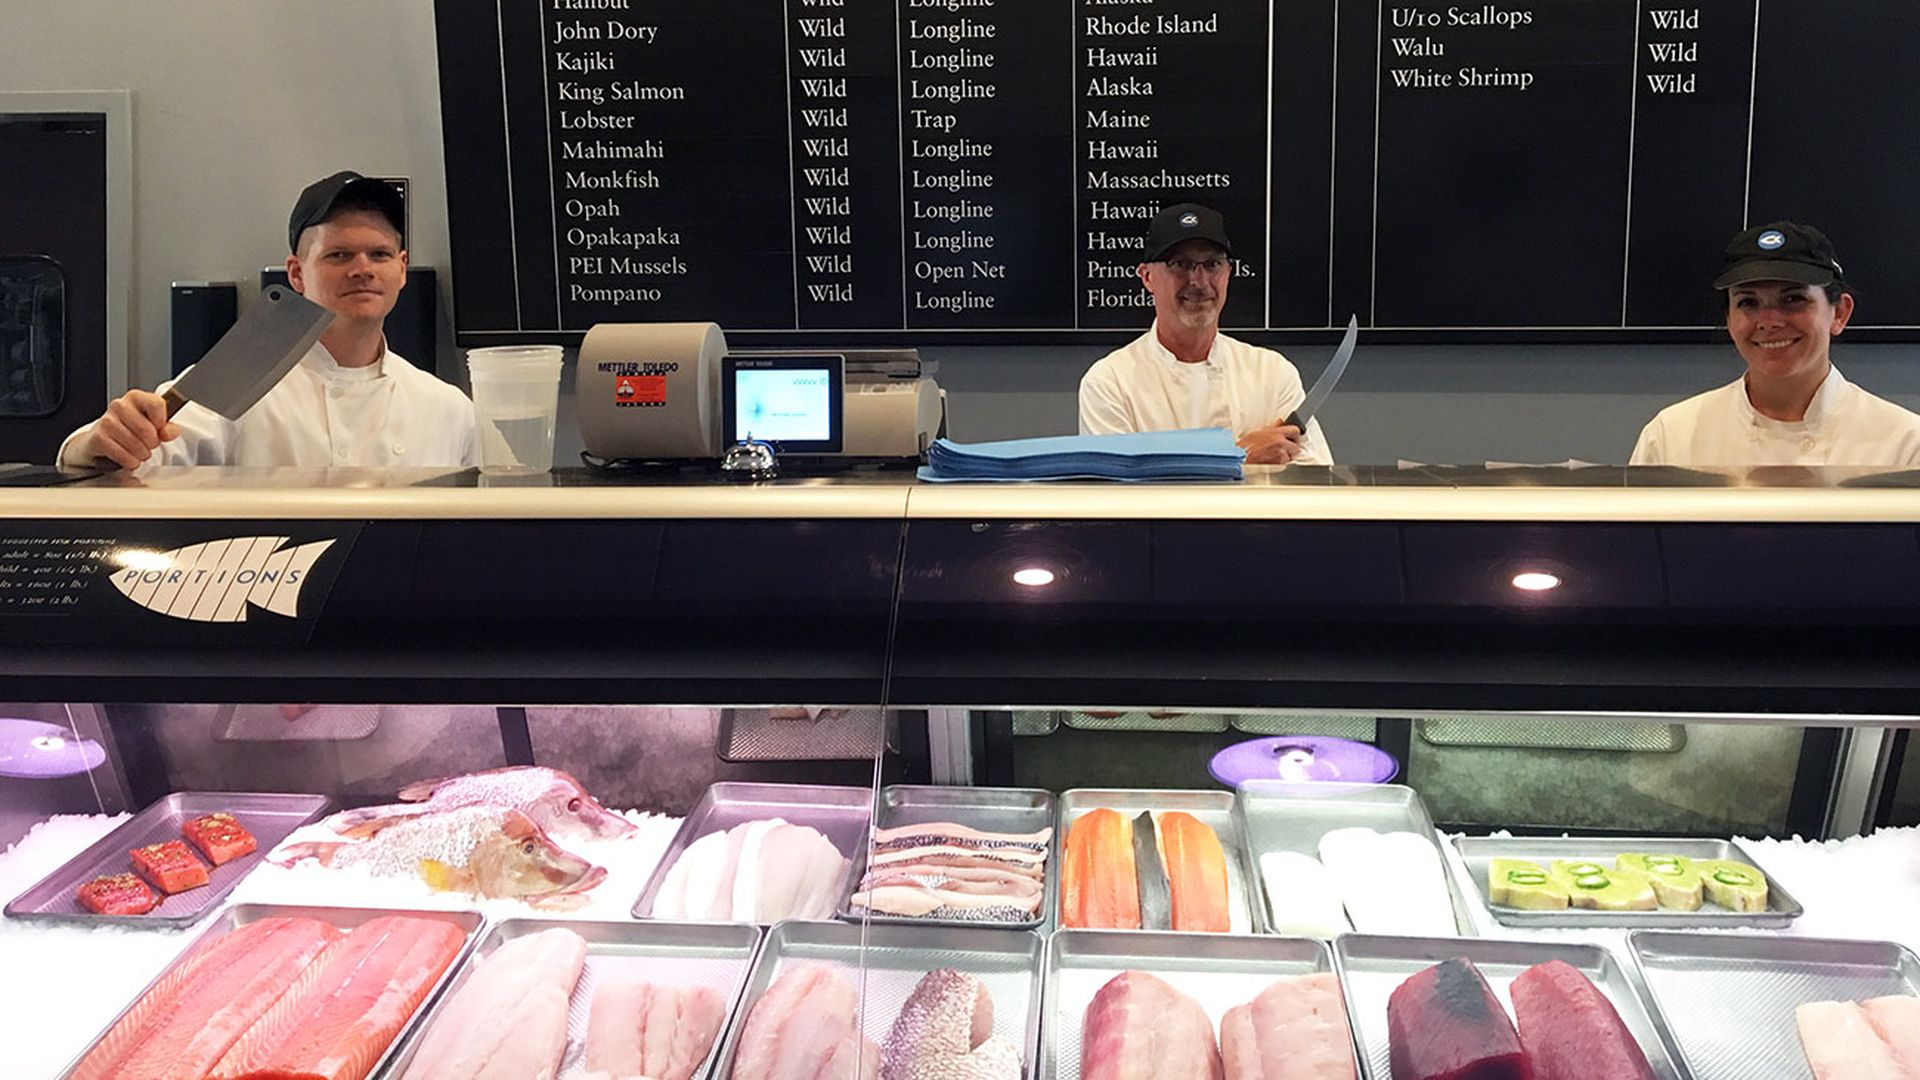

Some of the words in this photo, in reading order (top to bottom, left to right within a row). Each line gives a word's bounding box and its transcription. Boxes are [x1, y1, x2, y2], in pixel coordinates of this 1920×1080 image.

[798, 17, 845, 37] Wild
[1086, 14, 1151, 36] Rhode
[1156, 12, 1218, 34] Island
[1447, 5, 1533, 30] Scallops
[1649, 8, 1699, 30] Wild
[553, 20, 601, 45] John
[607, 21, 658, 44] Dory
[910, 18, 996, 44] Longline
[799, 47, 846, 67] Wild
[1087, 46, 1158, 67] Hawaii
[1391, 36, 1444, 57] Walu
[1647, 41, 1697, 63] Wild
[556, 51, 615, 75] Kajiki
[910, 47, 995, 73] Longline
[800, 78, 847, 98] Wild
[1086, 76, 1153, 96] Alaska
[1390, 68, 1452, 87] White
[1458, 67, 1534, 91] Shrimp
[1646, 73, 1696, 94] Wild
[558, 82, 605, 105] King
[610, 80, 684, 100] Salmon
[911, 78, 996, 104] Longline
[561, 109, 635, 129] Lobster
[801, 107, 848, 127] Wild
[910, 109, 957, 133] Trap
[1086, 110, 1151, 128] Maine
[562, 139, 664, 159] Mahimahi
[802, 137, 849, 157] Wild
[912, 138, 993, 162] Longline
[1088, 140, 1158, 159] Hawaii
[566, 169, 660, 189] Monkfish
[803, 167, 849, 187] Wild
[913, 168, 993, 193] Longline
[1086, 168, 1230, 189] Massachusetts
[565, 198, 620, 221] Opah
[804, 196, 851, 215] Wild
[913, 199, 994, 223] Longline
[567, 226, 680, 250] Opakapaka
[805, 225, 851, 245] Wild
[914, 230, 994, 253] Longline
[1087, 231, 1149, 250] Hawa
[570, 257, 603, 274] PEI
[610, 256, 687, 275] Mussels
[806, 254, 852, 273] Wild
[914, 261, 965, 283] Open
[971, 260, 1005, 279] Net
[1233, 258, 1256, 278] Is.
[570, 284, 662, 306] Pompano
[807, 283, 853, 302] Wild
[916, 290, 995, 313] Longline
[1087, 288, 1157, 308] Florida
[598, 362, 638, 372] METTLER
[643, 362, 679, 372] TOLEDO
[123, 570, 301, 584] PORTIONS
